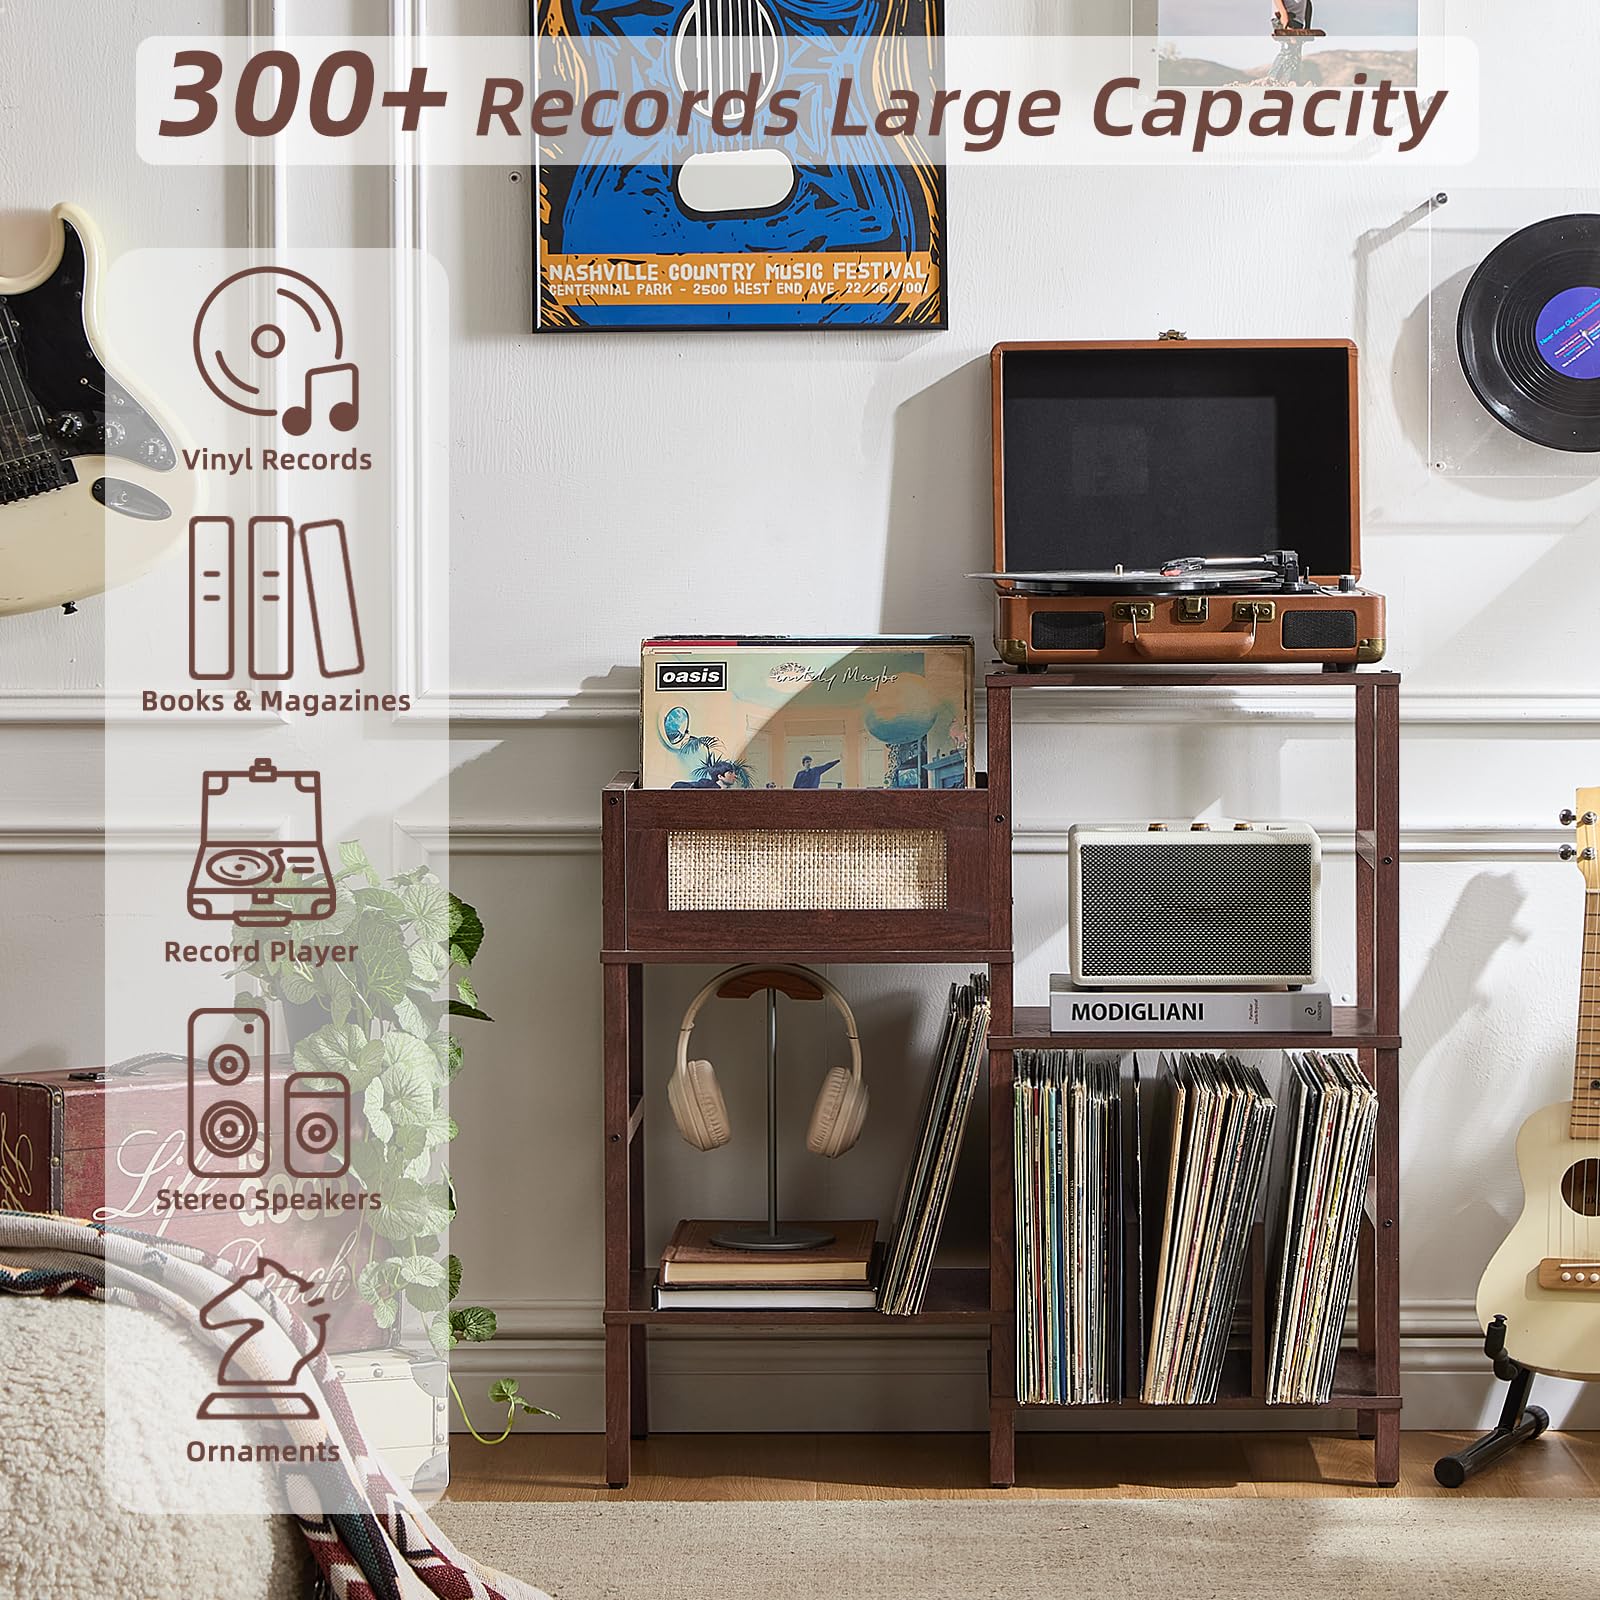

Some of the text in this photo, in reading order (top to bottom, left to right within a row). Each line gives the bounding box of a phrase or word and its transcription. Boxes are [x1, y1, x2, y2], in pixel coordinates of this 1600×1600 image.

[549, 261, 929, 282] NASHVILLE COUNTRY MUSIC FESTIVAL
[549, 282, 631, 297] CENTENNIAL
[636, 282, 673, 296] PARK
[692, 282, 728, 296] 2500
[733, 281, 771, 296] WEST
[776, 281, 803, 295] END
[845, 281, 930, 296] 22/06/001
[662, 667, 721, 684] oasis
[842, 665, 899, 692] Maybe
[1071, 1002, 1204, 1021] MODIGLIANI
